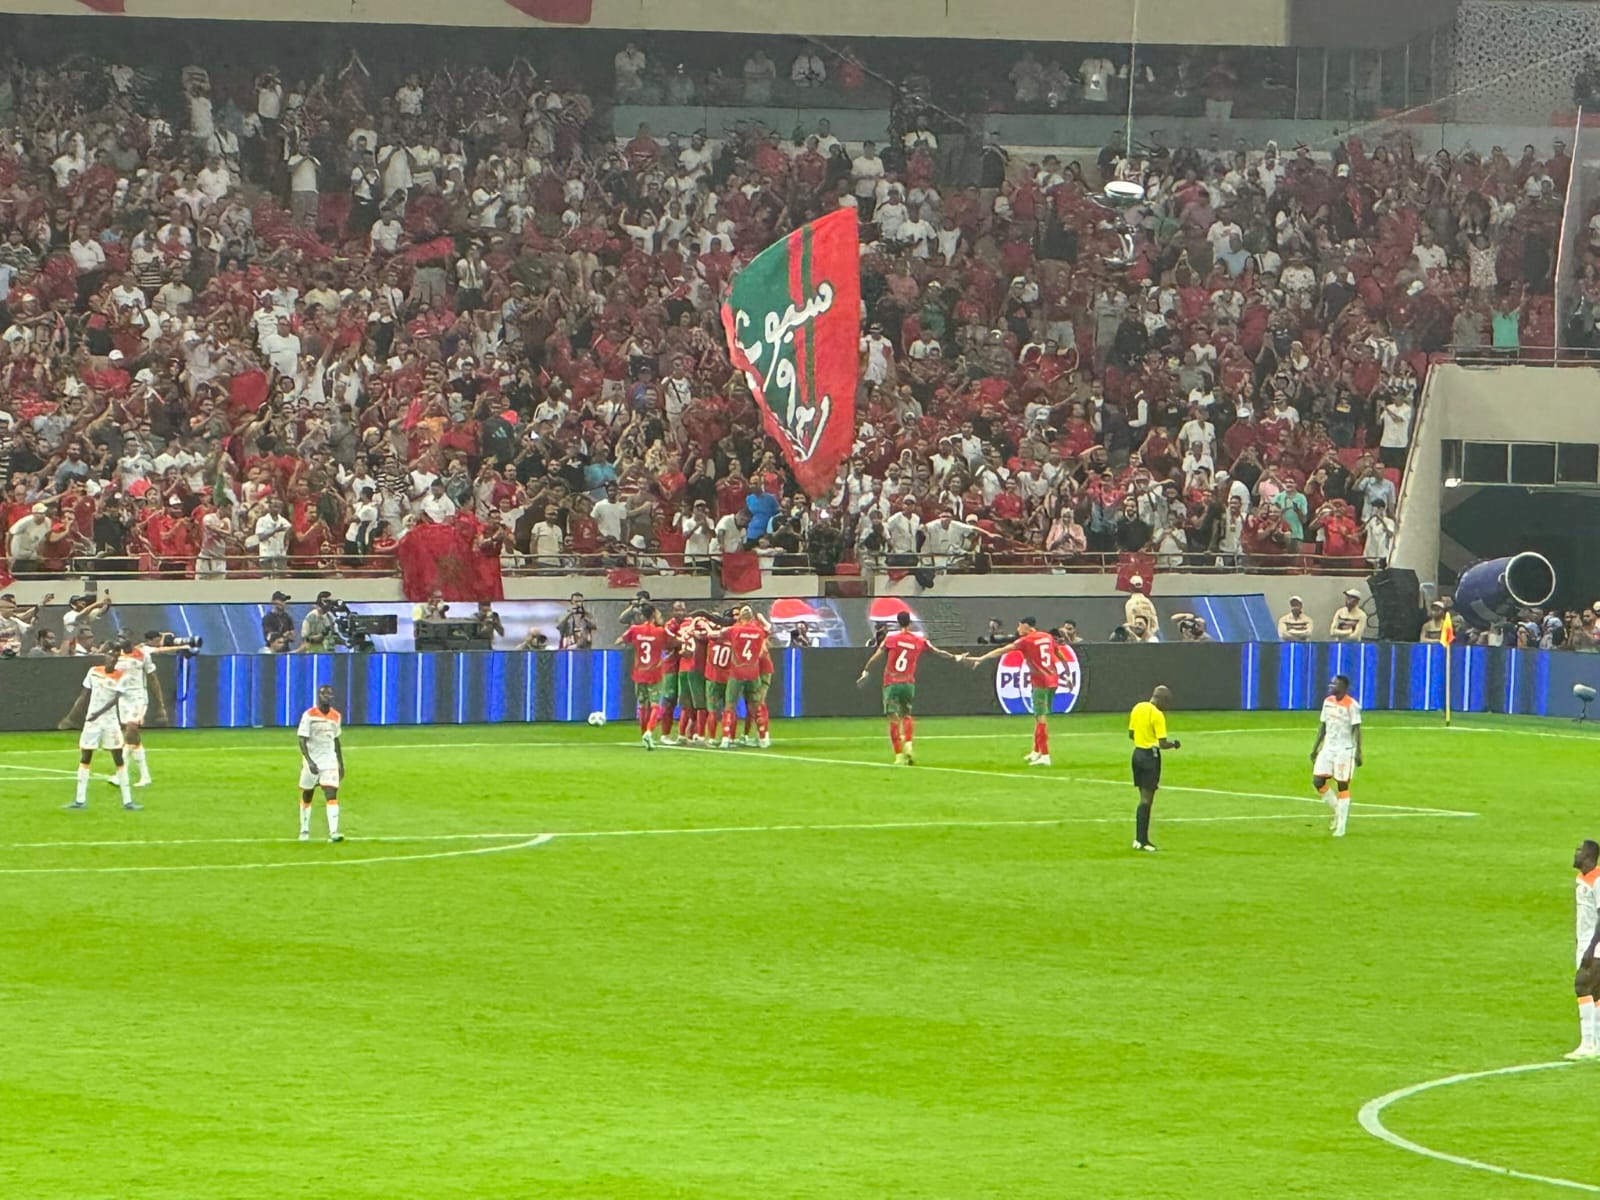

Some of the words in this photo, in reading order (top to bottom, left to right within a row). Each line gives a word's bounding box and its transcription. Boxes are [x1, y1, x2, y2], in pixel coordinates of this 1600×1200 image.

[640, 642, 651, 664] 3
[712, 644, 731, 667] 10
[742, 640, 752, 660] 4
[895, 649, 907, 672] 6
[1039, 644, 1051, 667] 5
